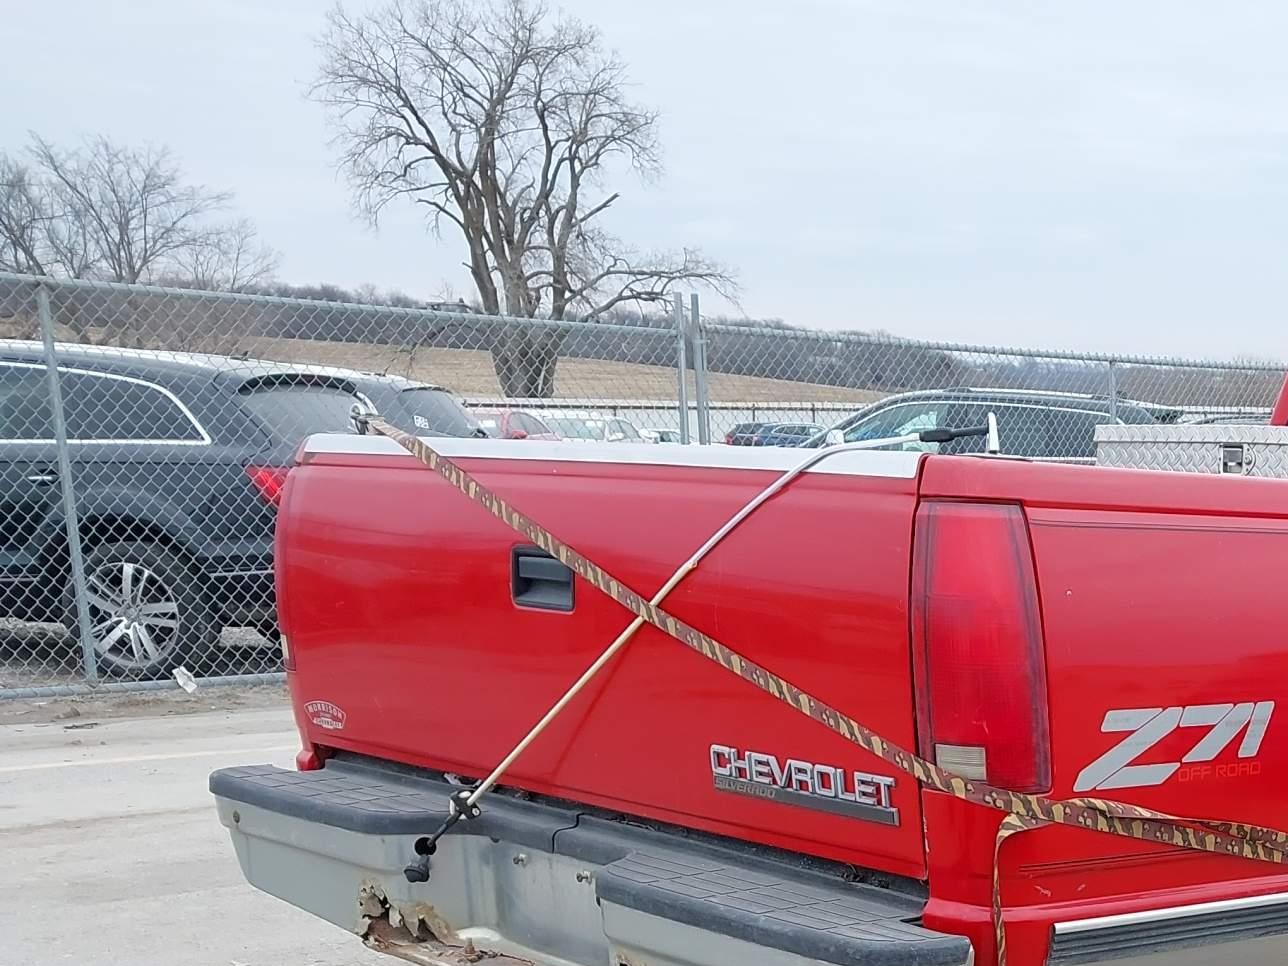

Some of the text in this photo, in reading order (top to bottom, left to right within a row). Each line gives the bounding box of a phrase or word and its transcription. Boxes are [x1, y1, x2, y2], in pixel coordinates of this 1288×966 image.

[1073, 701, 1275, 792] Z71
[710, 744, 896, 808] CHEVROLET
[715, 779, 776, 799] SILVERADO
[1178, 761, 1261, 782] OFF ROAD
